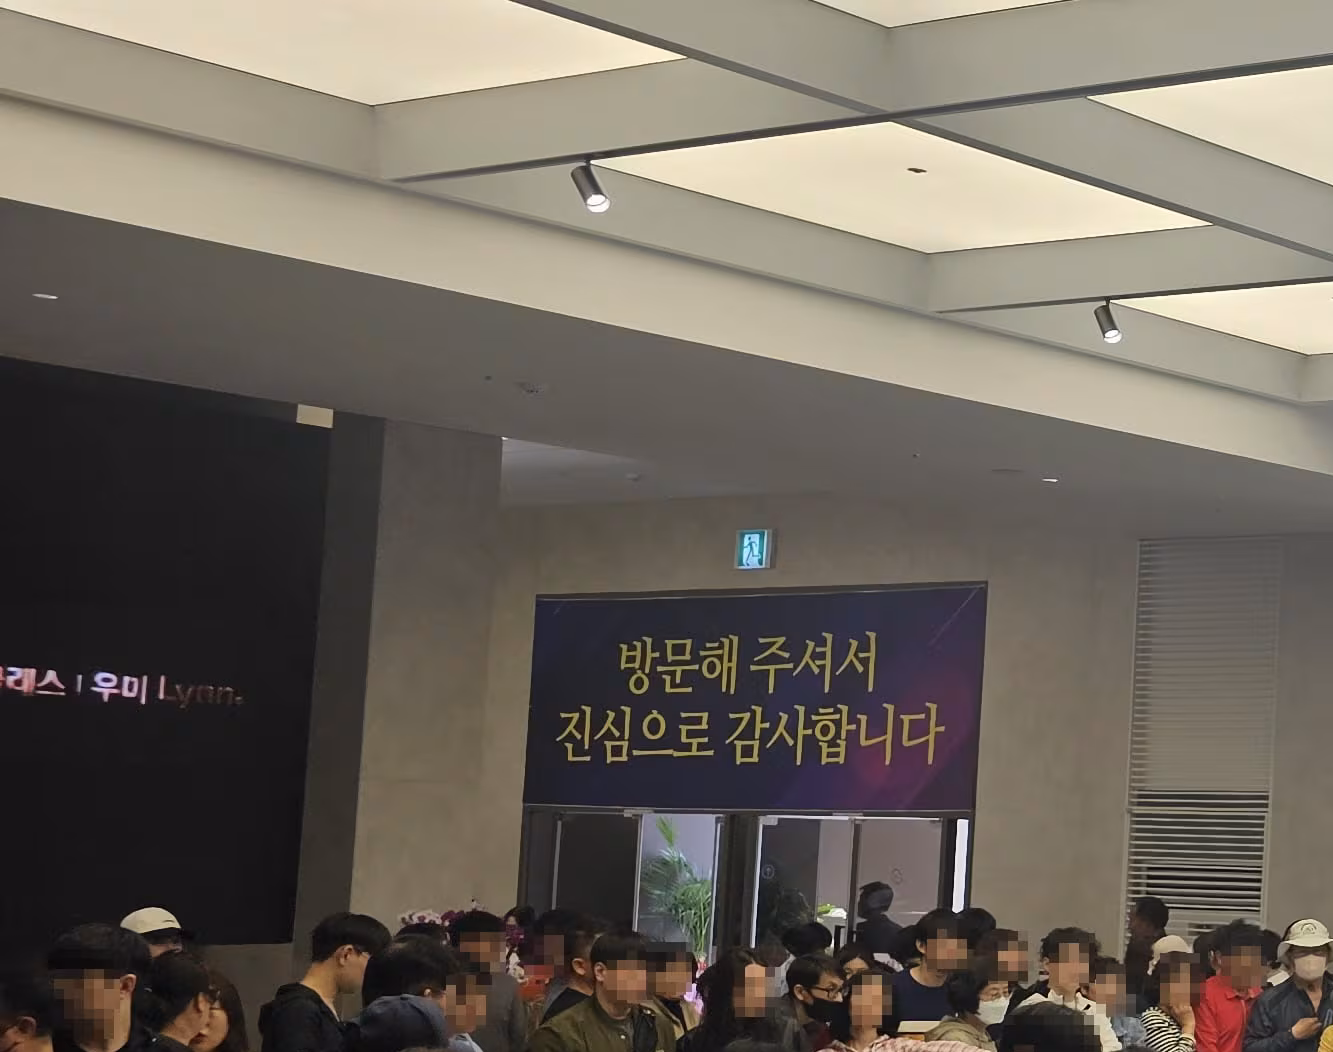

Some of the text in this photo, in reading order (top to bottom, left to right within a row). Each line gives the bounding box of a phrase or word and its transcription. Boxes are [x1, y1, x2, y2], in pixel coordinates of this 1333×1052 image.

[90, 670, 148, 705] 우미
[619, 630, 877, 695] 방문해 주셔서
[556, 702, 945, 766] 진심으로 감사합니다
